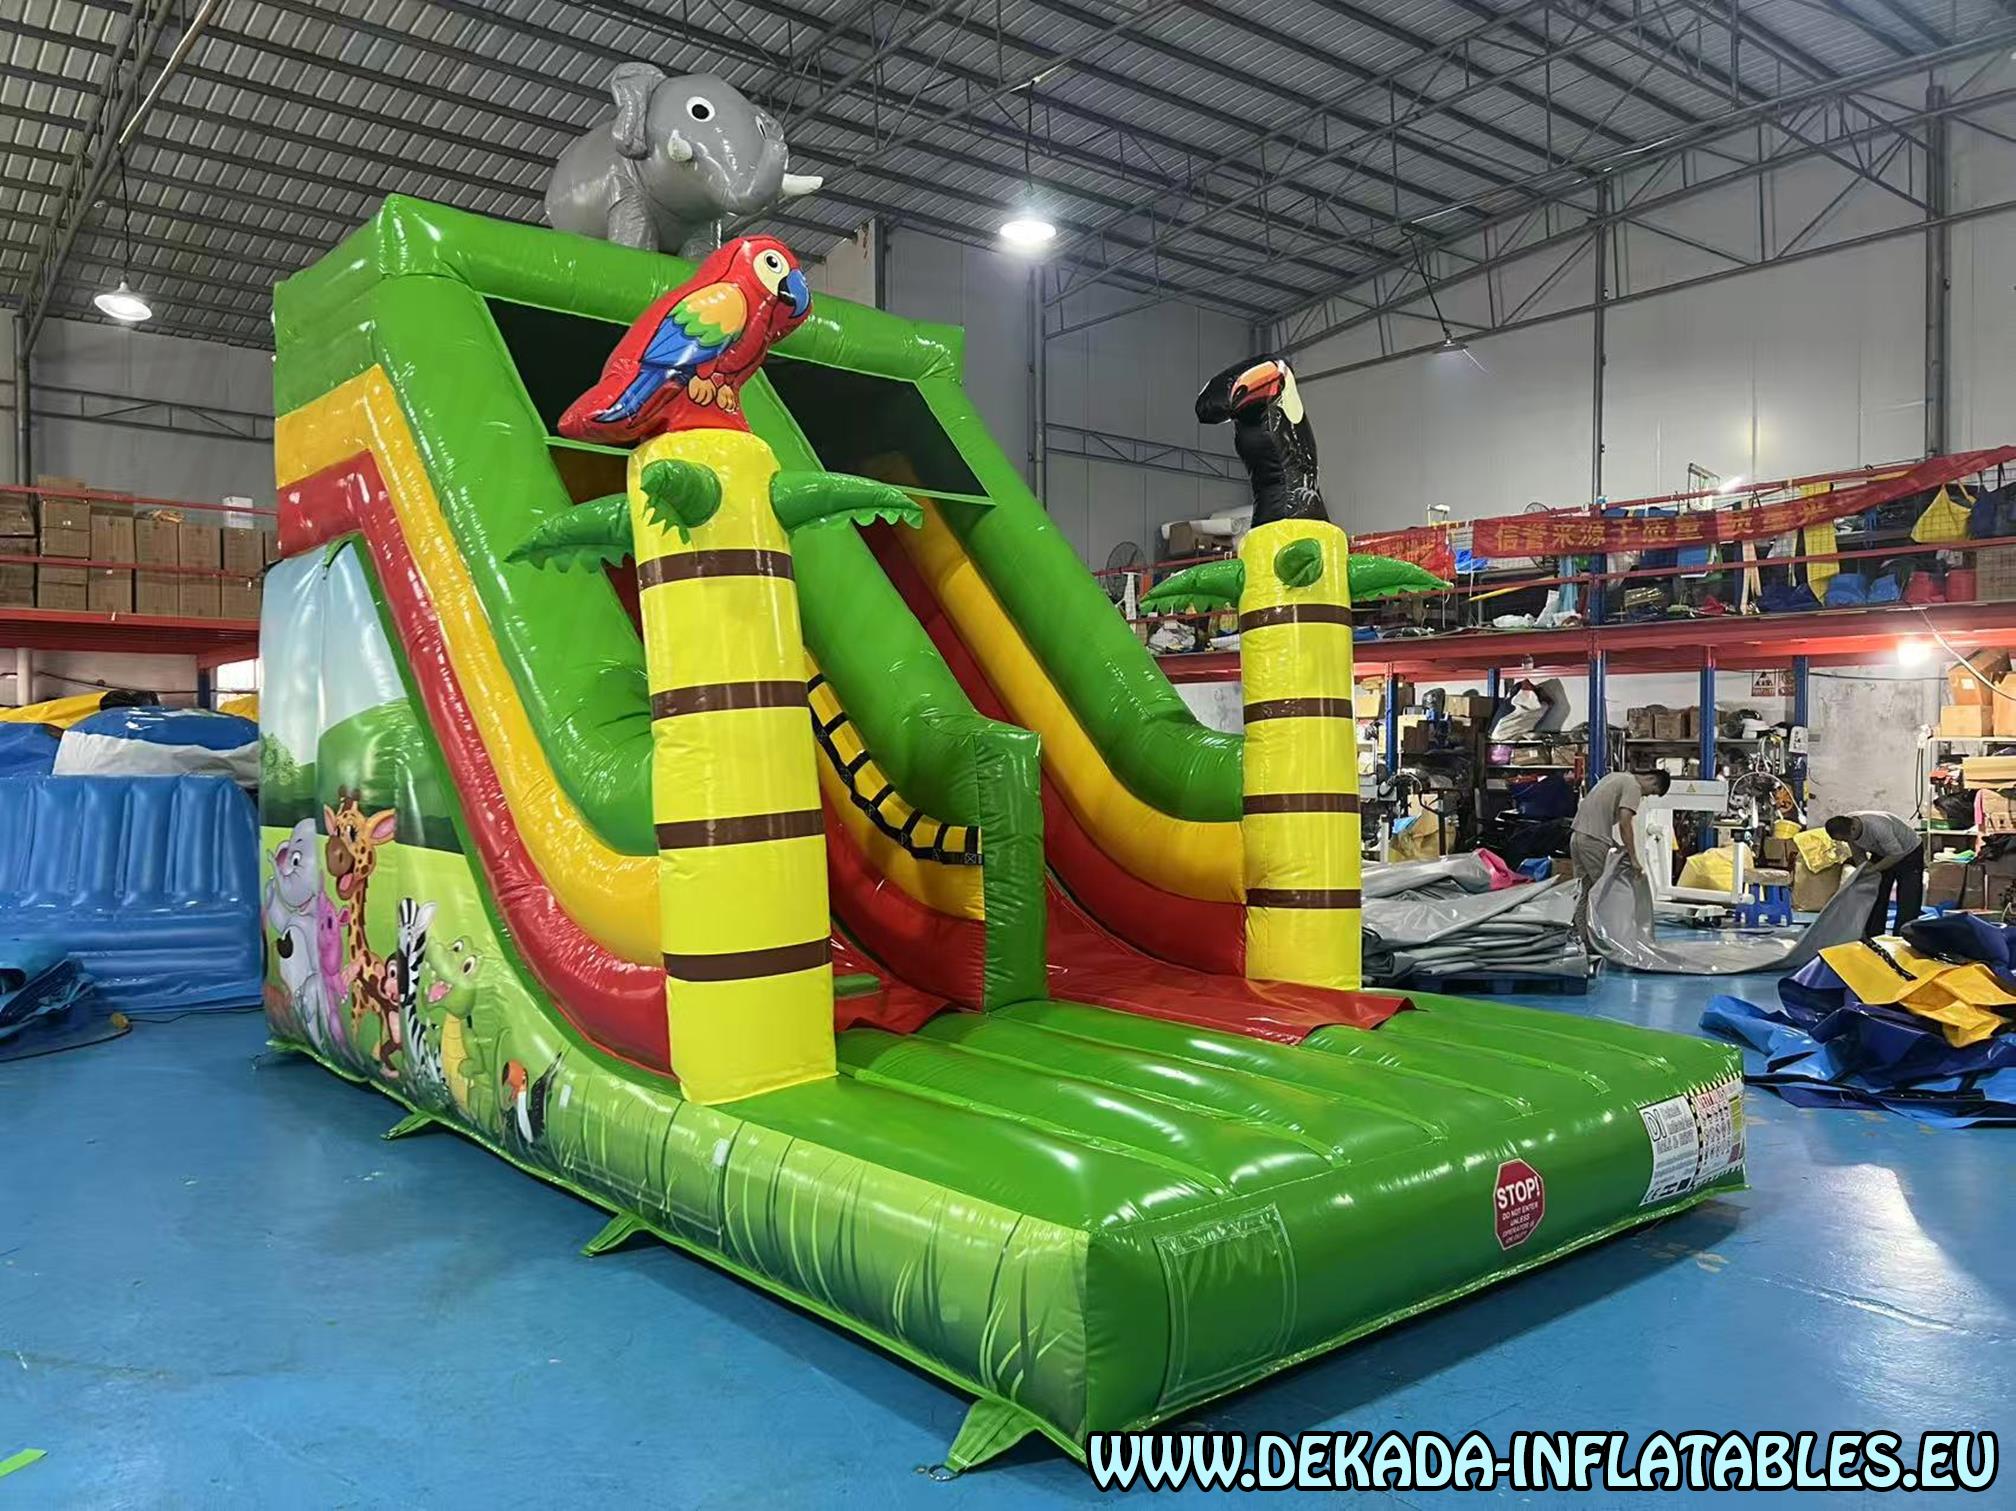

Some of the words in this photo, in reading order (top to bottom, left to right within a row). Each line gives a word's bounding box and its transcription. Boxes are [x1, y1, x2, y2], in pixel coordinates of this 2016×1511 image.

[1497, 1176, 1540, 1209] STOP!
[1502, 1211, 1511, 1221] DO
[1511, 1207, 1521, 1217] NOT
[1522, 1202, 1538, 1213] ENTER
[1510, 1213, 1530, 1226] UNLESS
